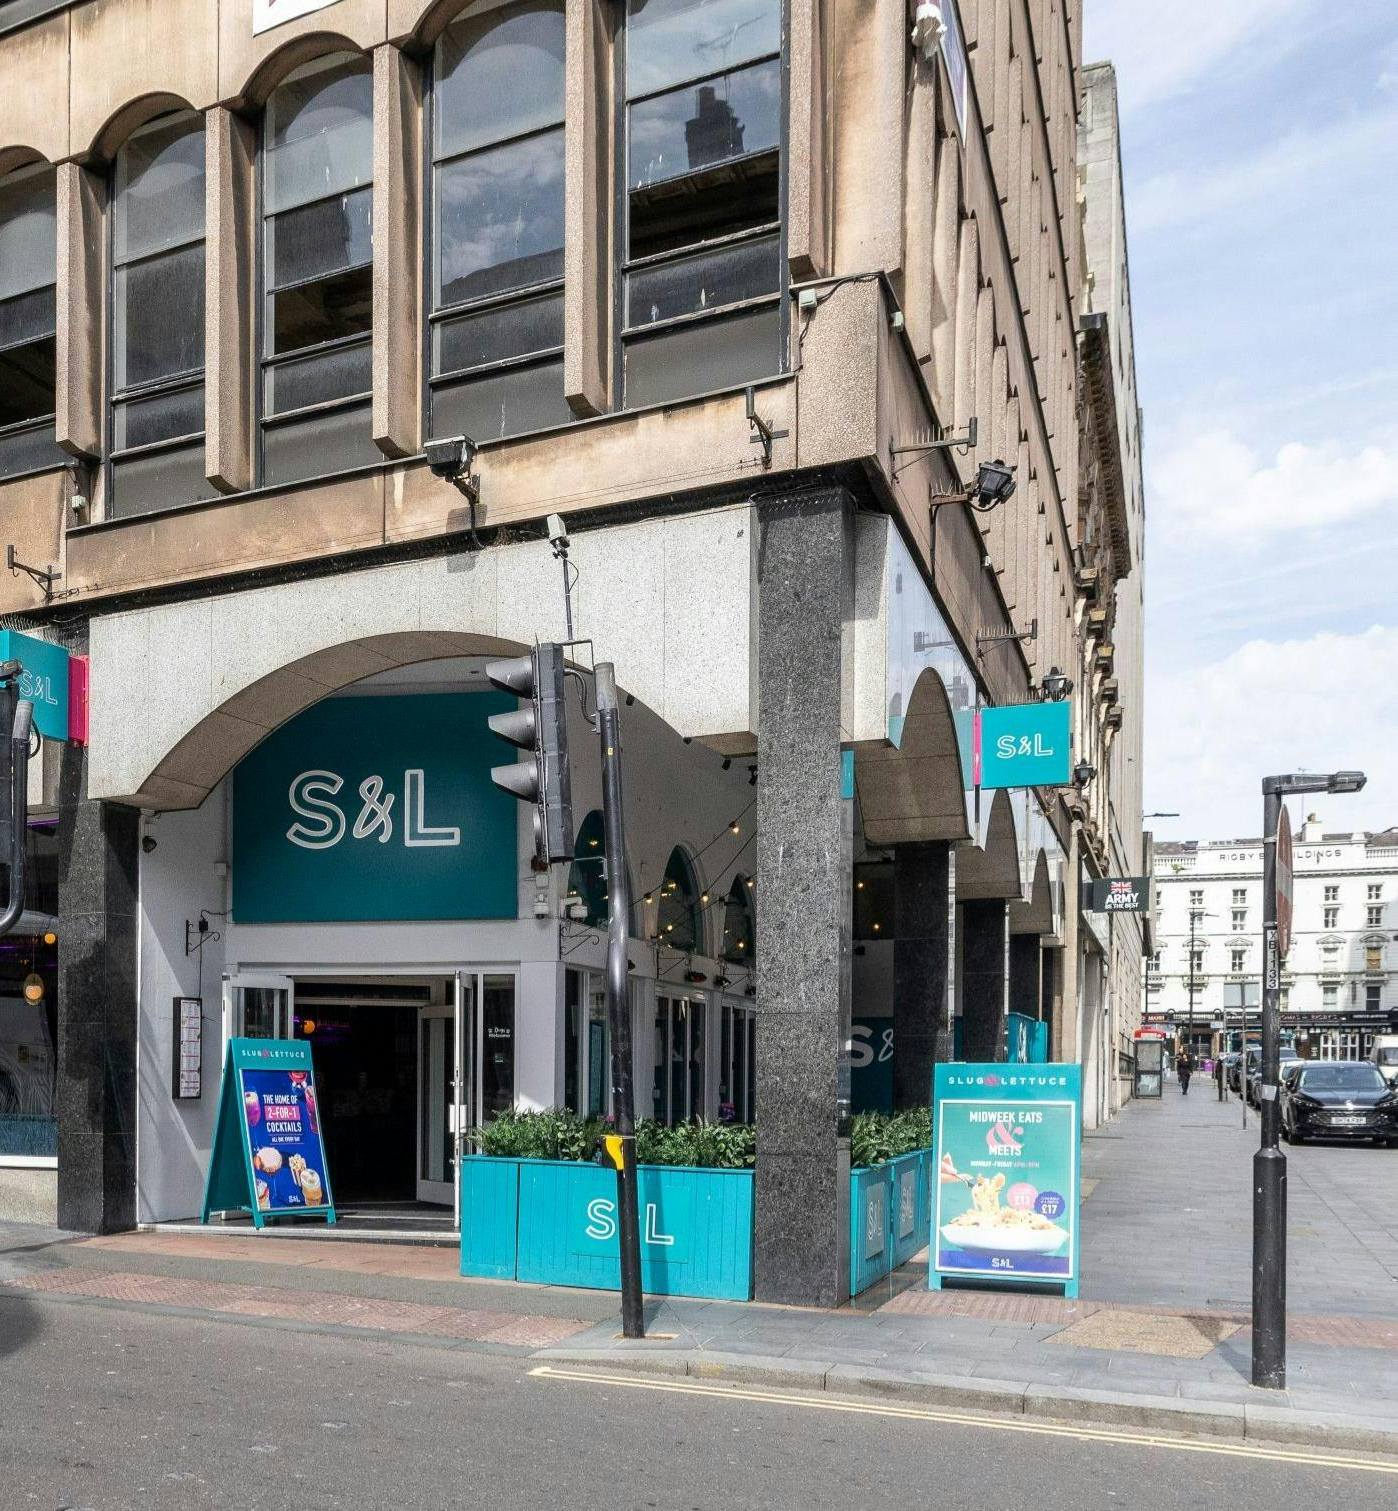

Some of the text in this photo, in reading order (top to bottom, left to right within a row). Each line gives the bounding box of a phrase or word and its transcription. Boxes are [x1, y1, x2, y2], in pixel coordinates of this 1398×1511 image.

[996, 733, 1054, 759] S&L
[286, 768, 461, 850] S&L
[1105, 893, 1140, 905] ARMY
[263, 1094, 298, 1104] THE HOME OF
[267, 1105, 297, 1119] 2-FOR-1
[969, 1111, 1043, 1123] MIDWEEK EATS
[266, 1121, 302, 1133] COCKTAILS
[988, 1145, 1022, 1157] MEETS
[1041, 1204, 1058, 1215] £17
[585, 1198, 675, 1246] SL
[991, 1257, 1015, 1269] S&L
